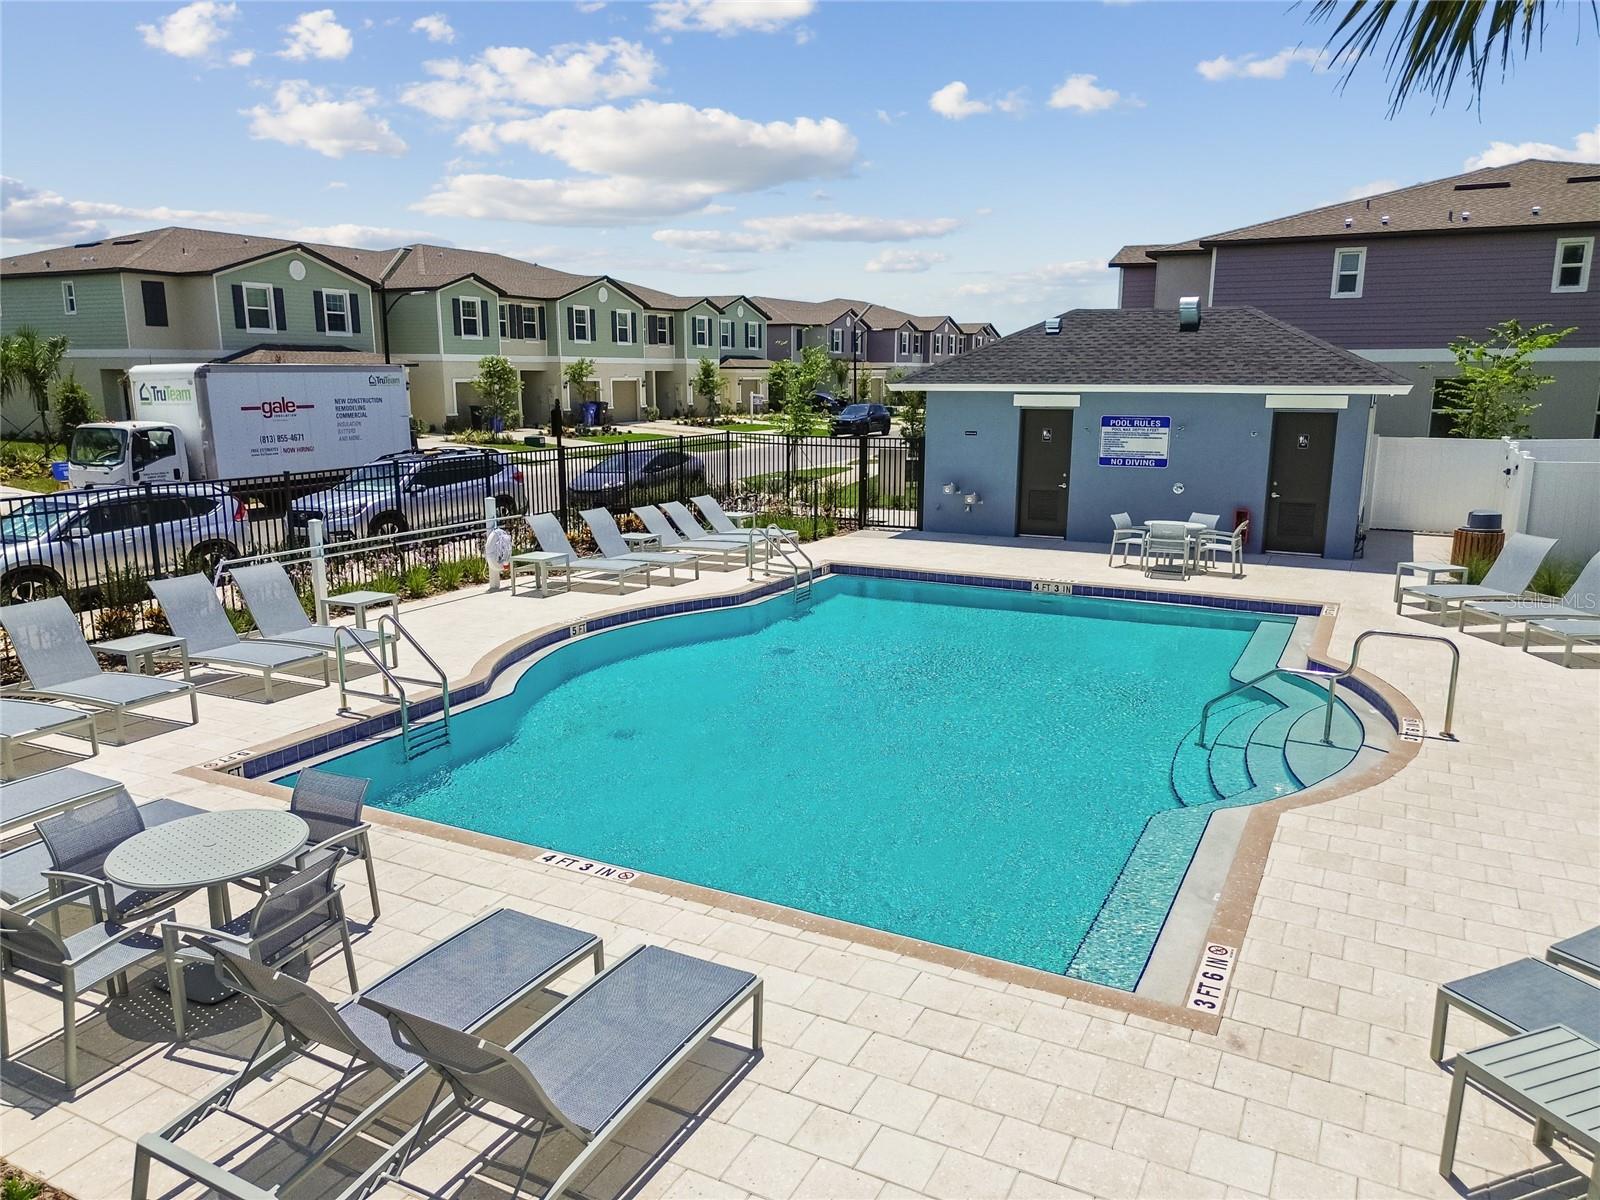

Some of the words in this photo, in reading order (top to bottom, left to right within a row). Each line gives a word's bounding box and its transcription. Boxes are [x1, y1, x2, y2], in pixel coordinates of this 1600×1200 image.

[376, 376, 400, 384] TruTeam
[150, 385, 191, 401] TruTeam
[261, 396, 296, 418] gale
[335, 404, 366, 412] REMODELING
[335, 411, 368, 419] COMMERCIAL
[1110, 419, 1131, 427] POOL
[1133, 419, 1161, 427] RULES
[259, 434, 276, 445] (813)
[277, 433, 305, 443] 855-4671
[1125, 459, 1156, 467] DIVING
[1033, 583, 1039, 591] 4
[1042, 583, 1051, 592] FT
[1054, 584, 1060, 593] 3
[1062, 585, 1071, 594] IN
[572, 627, 577, 635] 5
[541, 854, 557, 863] 4
[555, 857, 580, 868] FT
[579, 863, 594, 871] 3
[594, 866, 617, 877] IN
[1204, 956, 1229, 971] IN
[1201, 971, 1225, 982] 6
[1196, 981, 1222, 999] FT
[1193, 998, 1217, 1010] 3
